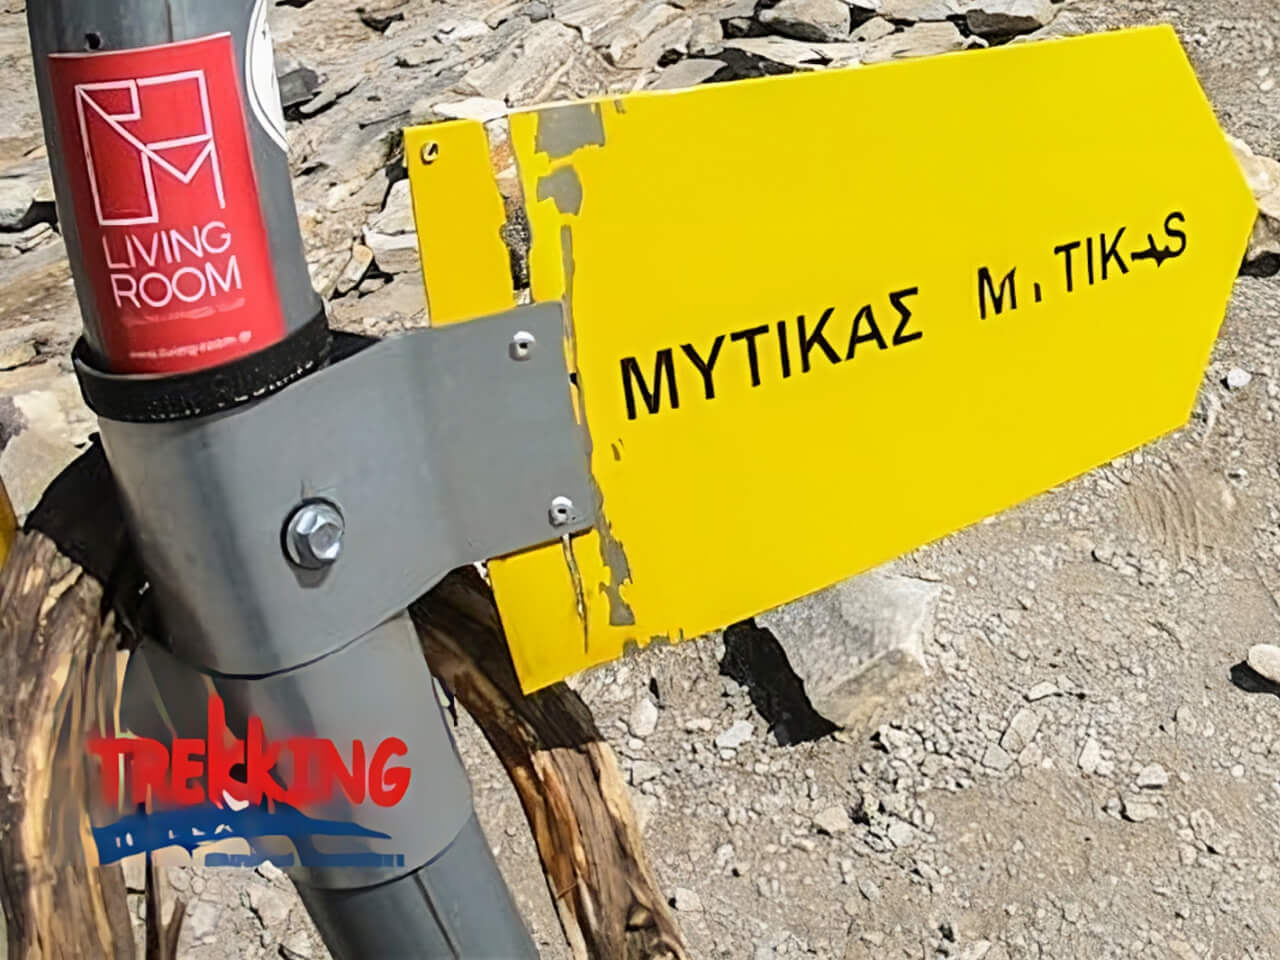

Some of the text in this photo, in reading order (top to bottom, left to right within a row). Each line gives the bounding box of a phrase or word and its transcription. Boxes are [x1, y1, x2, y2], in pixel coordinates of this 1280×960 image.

[101, 220, 232, 269] LIVING
[110, 254, 243, 309] ROOM
[619, 210, 1188, 421] ΜΥΤΙΚΑΣ MTIKS
